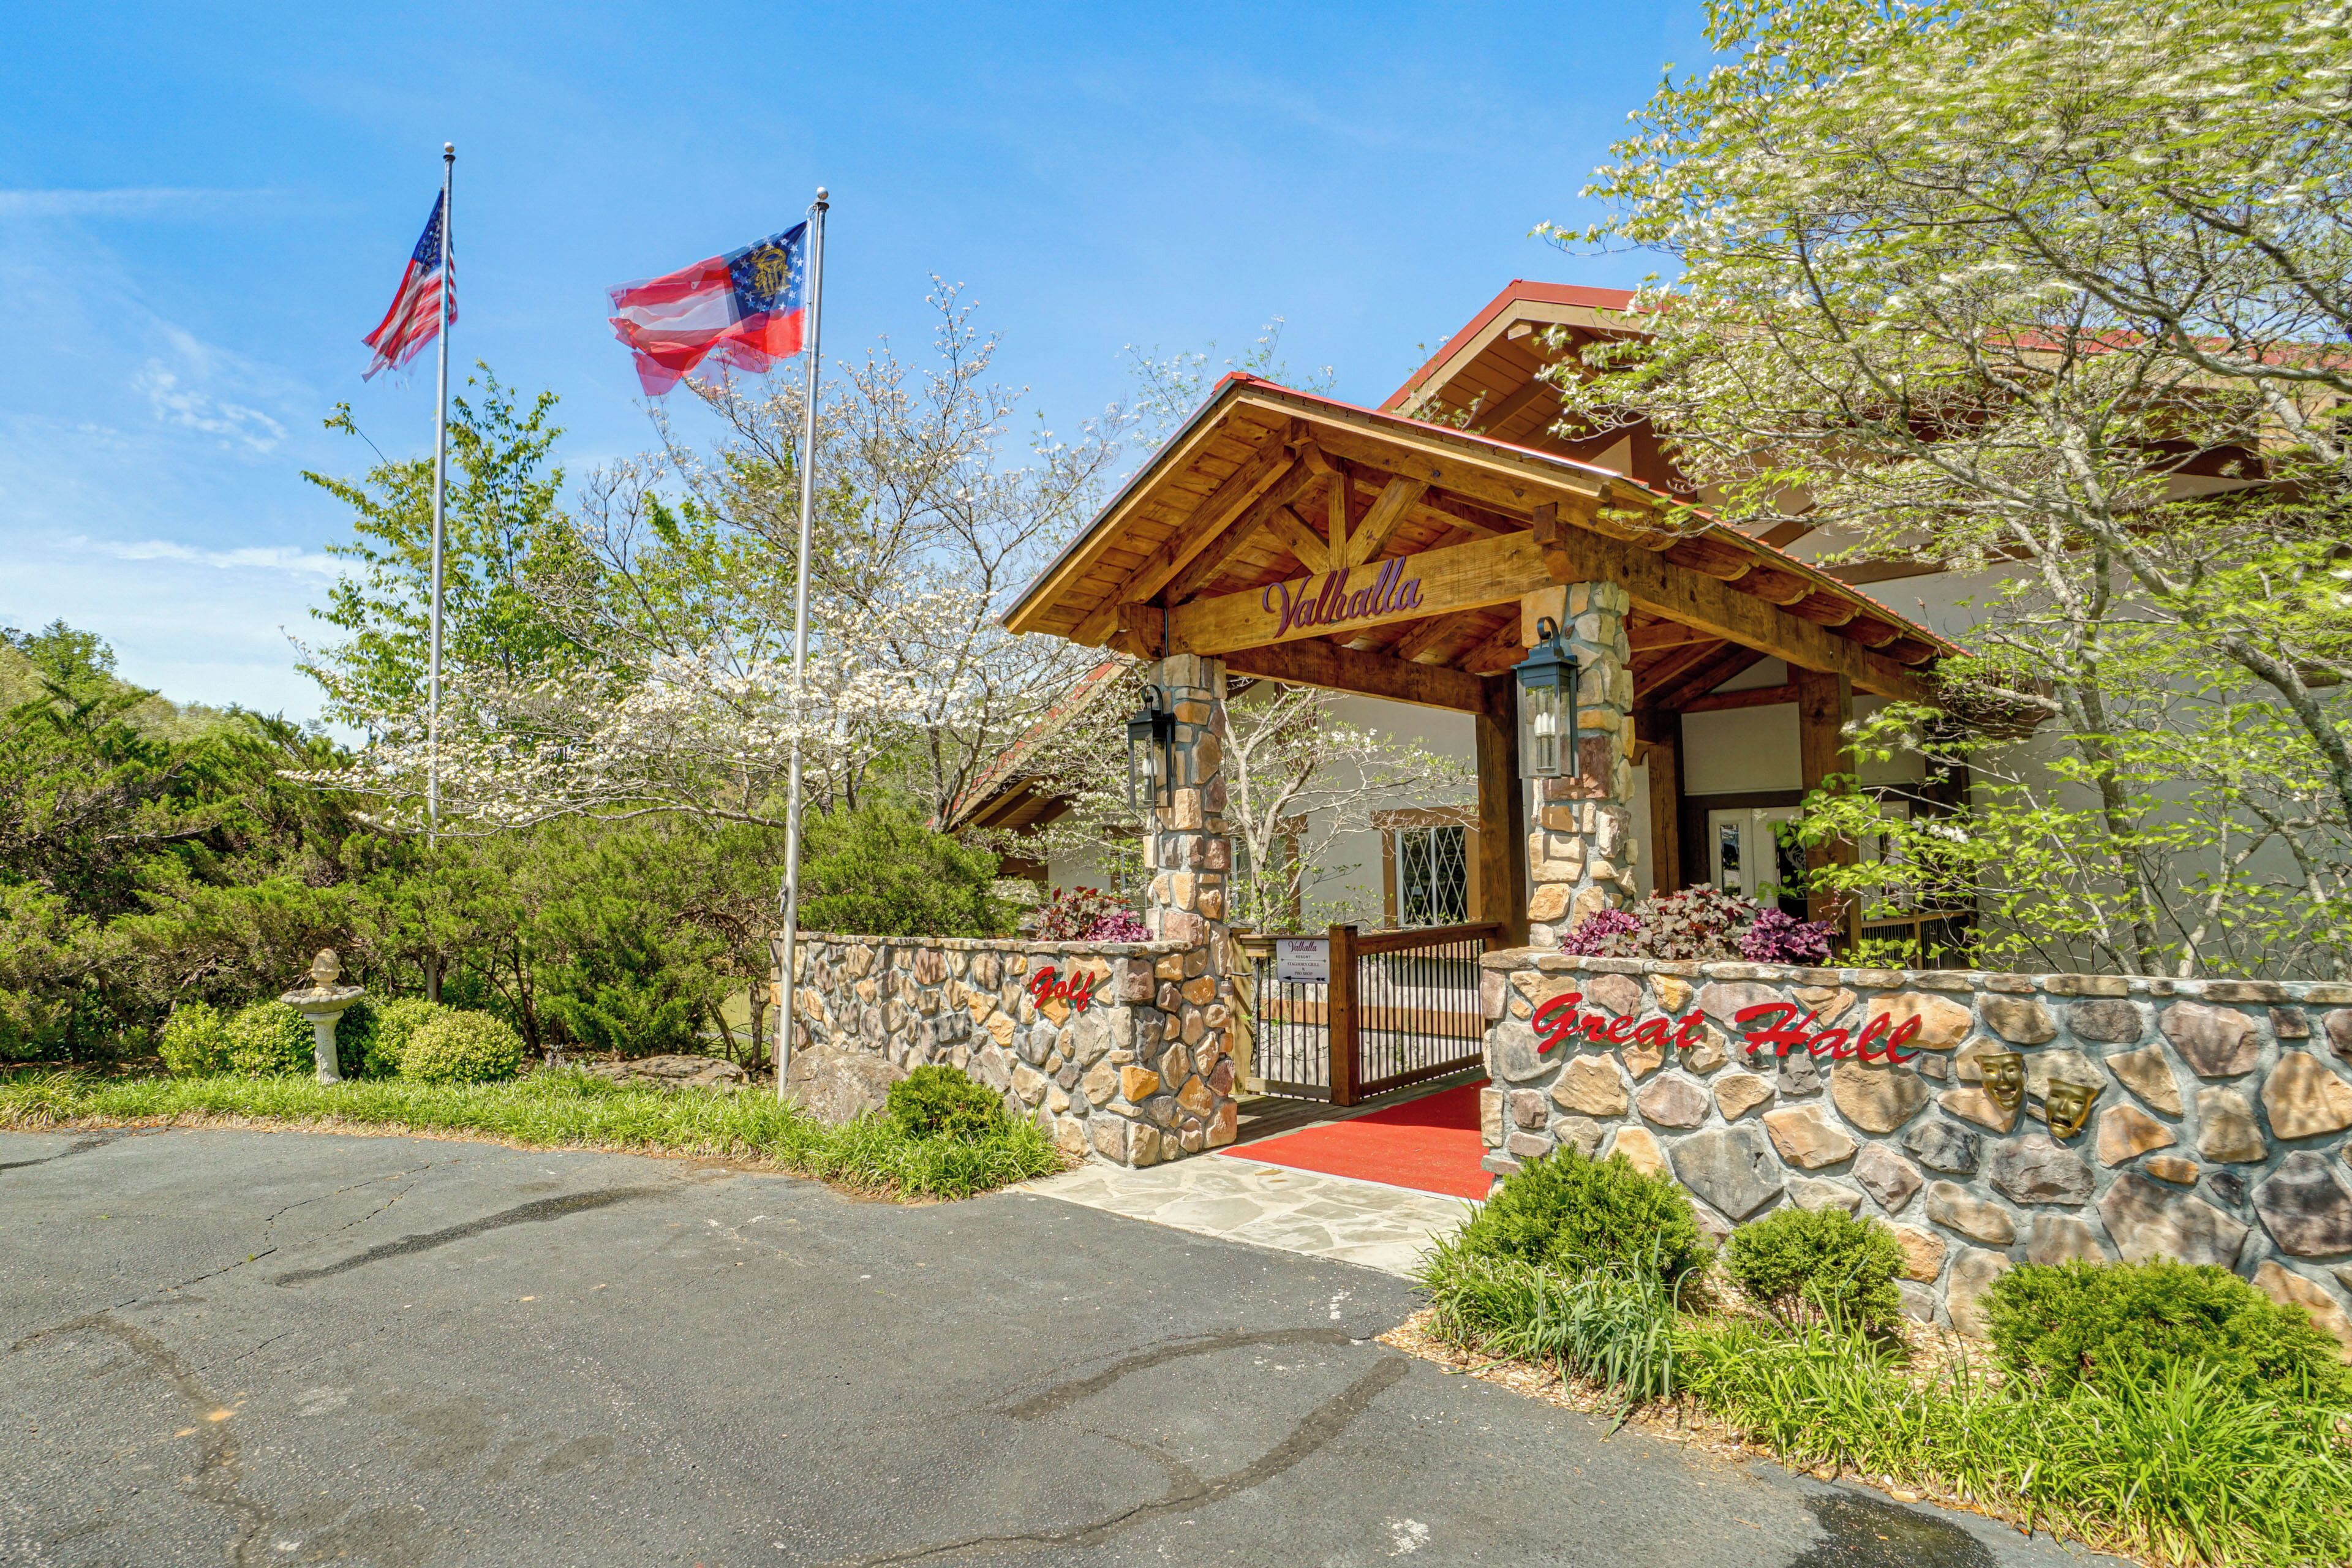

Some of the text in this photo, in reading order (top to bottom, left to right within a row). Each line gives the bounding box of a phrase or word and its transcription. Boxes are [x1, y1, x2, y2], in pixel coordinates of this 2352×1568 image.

[1262, 556, 1423, 639] Valhalla
[1288, 940, 1317, 952] Valhalla
[1030, 966, 1095, 1012] Golf
[1531, 992, 1920, 1064] Great Hall
